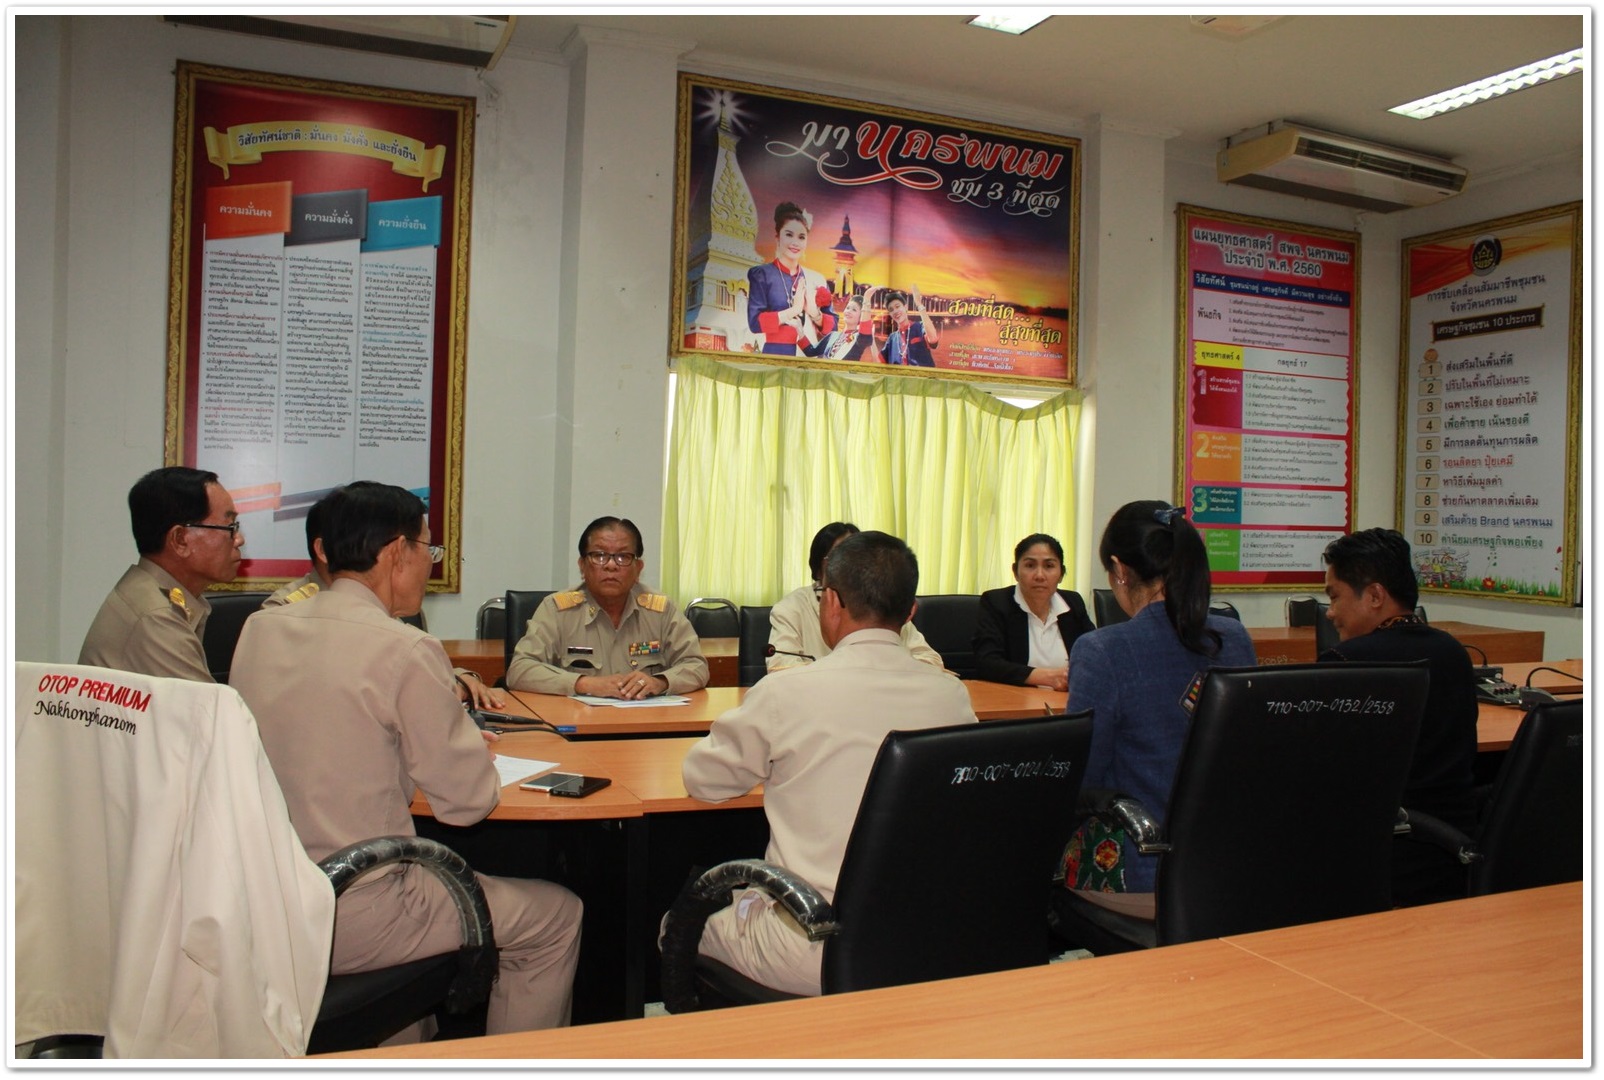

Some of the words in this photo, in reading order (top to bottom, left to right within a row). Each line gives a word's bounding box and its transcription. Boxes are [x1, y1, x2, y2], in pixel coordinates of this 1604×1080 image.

[238, 128, 301, 146] วิสัยทัศน์ชาติ
[310, 124, 338, 141] มั่นคง
[343, 128, 368, 147] มั่งคั่ง
[373, 139, 417, 162] และยั่งยืน
[947, 173, 991, 208] ชม
[988, 181, 1003, 200] 3
[1002, 179, 1066, 217] ที่สุด
[219, 202, 272, 218] ความมั่นคง
[305, 208, 353, 225] ความมั่งคั่ง
[378, 215, 427, 231] ความยั่งยืน
[1194, 229, 1272, 251] แผนยุทธศาสตร์
[1279, 242, 1304, 256] สพจ.
[1307, 247, 1349, 263] นครพนม
[1225, 250, 1264, 268] ประจำปี
[1268, 259, 1290, 272] พ.ศ.
[1294, 262, 1321, 276] 2560
[1196, 274, 1226, 287] วิสัยทัศน์
[1450, 294, 1517, 313] จังหวัดนครพนม
[999, 318, 1062, 349] สู่สุขที่สุด
[1436, 320, 1490, 336] เศรษฐกิจชุมชน
[1493, 317, 1504, 327] 10
[1505, 313, 1536, 326] ประการ
[1300, 360, 1307, 368] 17
[1428, 365, 1433, 375] 1
[1446, 351, 1513, 372] ส่งเสริมในพื้นที่ดี
[1197, 369, 1206, 395] 1
[1427, 383, 1434, 393] 2
[1445, 371, 1530, 392] ปรับในพื้นที่ไม่เหมาะ
[1427, 402, 1434, 412] 3
[1444, 397, 1492, 411] เฉพาะใช้เอง
[1496, 391, 1538, 406] ย่อมทำได้
[1426, 420, 1433, 430] 4
[1444, 414, 1485, 430] เพื่อค้าขาย
[1488, 413, 1529, 427] เน้นของดี
[1196, 433, 1210, 458] 2
[1425, 440, 1432, 450] 5
[1425, 459, 1432, 469] 6
[1484, 454, 1514, 470] ปุ๋ยเคมี
[1424, 478, 1431, 487] 7
[1442, 473, 1502, 489] หาวิธีเพิ่มมูลค่า
[1193, 487, 1208, 513] 3
[1424, 496, 1431, 506] 8
[1442, 491, 1538, 507] ช่วยกันหาตลาดเพิ่มเติม
[1423, 514, 1430, 524] 9
[1441, 513, 1477, 526] เสริมด้วย
[1480, 516, 1509, 527] Brand
[1512, 518, 1553, 527] นครพนม
[1420, 533, 1432, 544] 10
[38, 674, 79, 695] OTOP
[79, 678, 152, 712] PREMIUM
[1266, 695, 1395, 714] 7110-007-0132/2558
[34, 700, 137, 735] Nakhonphanom
